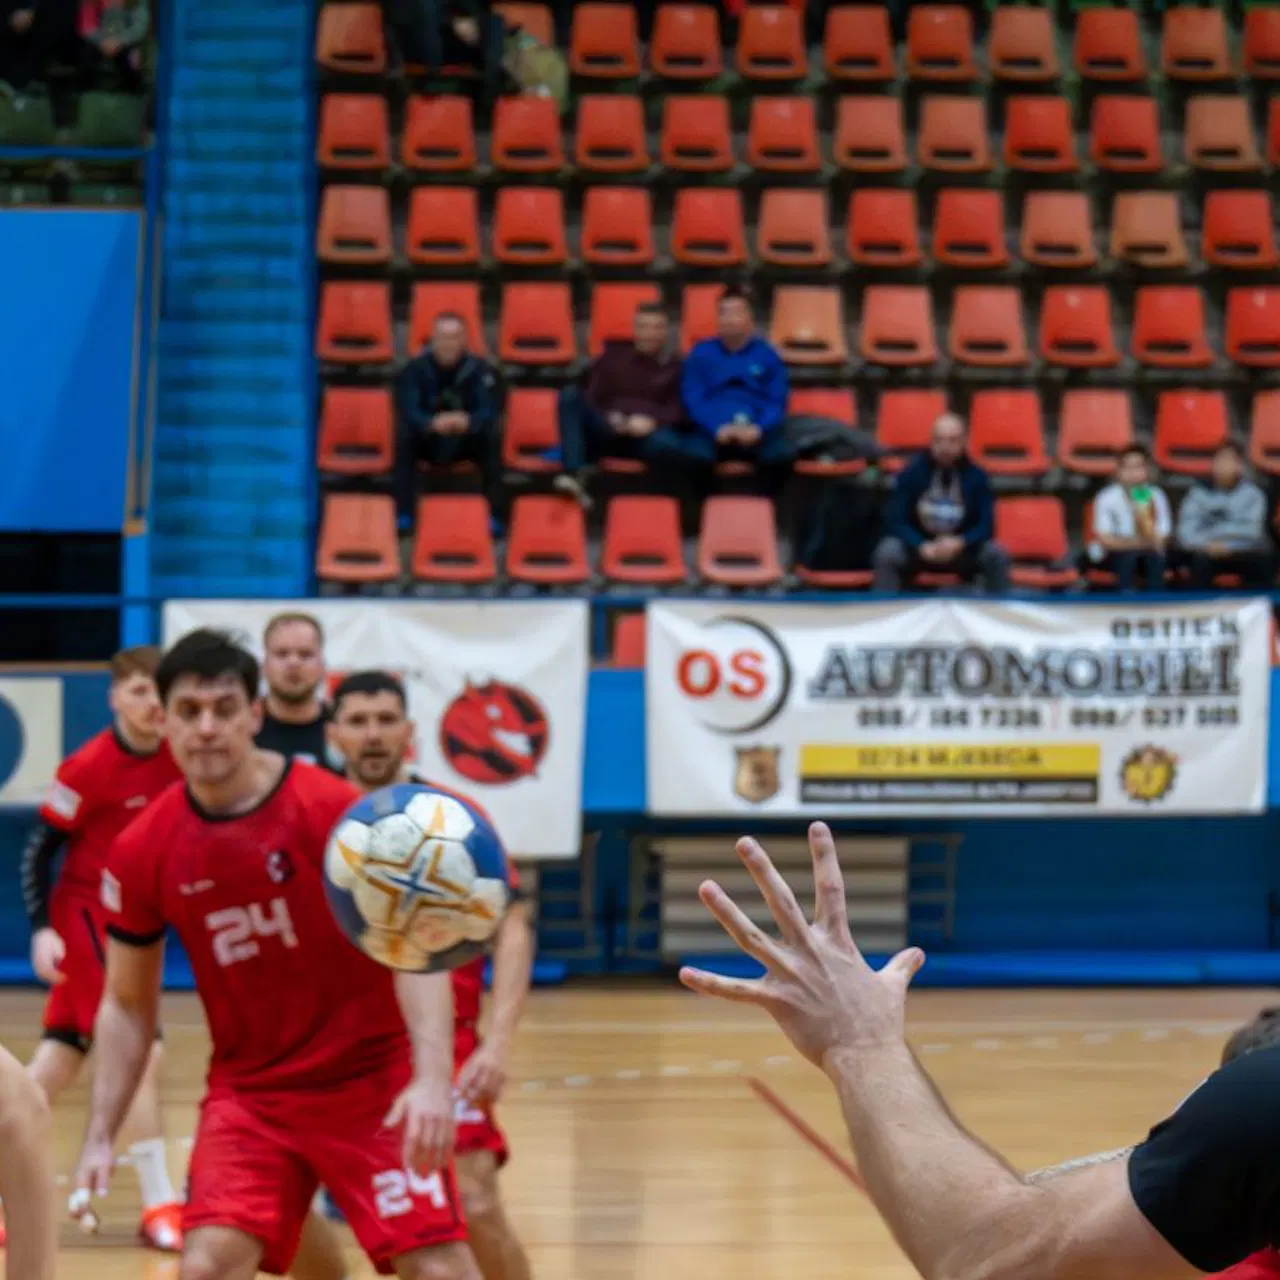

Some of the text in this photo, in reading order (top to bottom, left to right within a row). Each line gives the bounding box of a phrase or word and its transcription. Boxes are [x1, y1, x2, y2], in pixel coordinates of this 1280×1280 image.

[676, 649, 767, 700] OS
[204, 897, 299, 966] 24
[371, 1166, 446, 1218] 24
